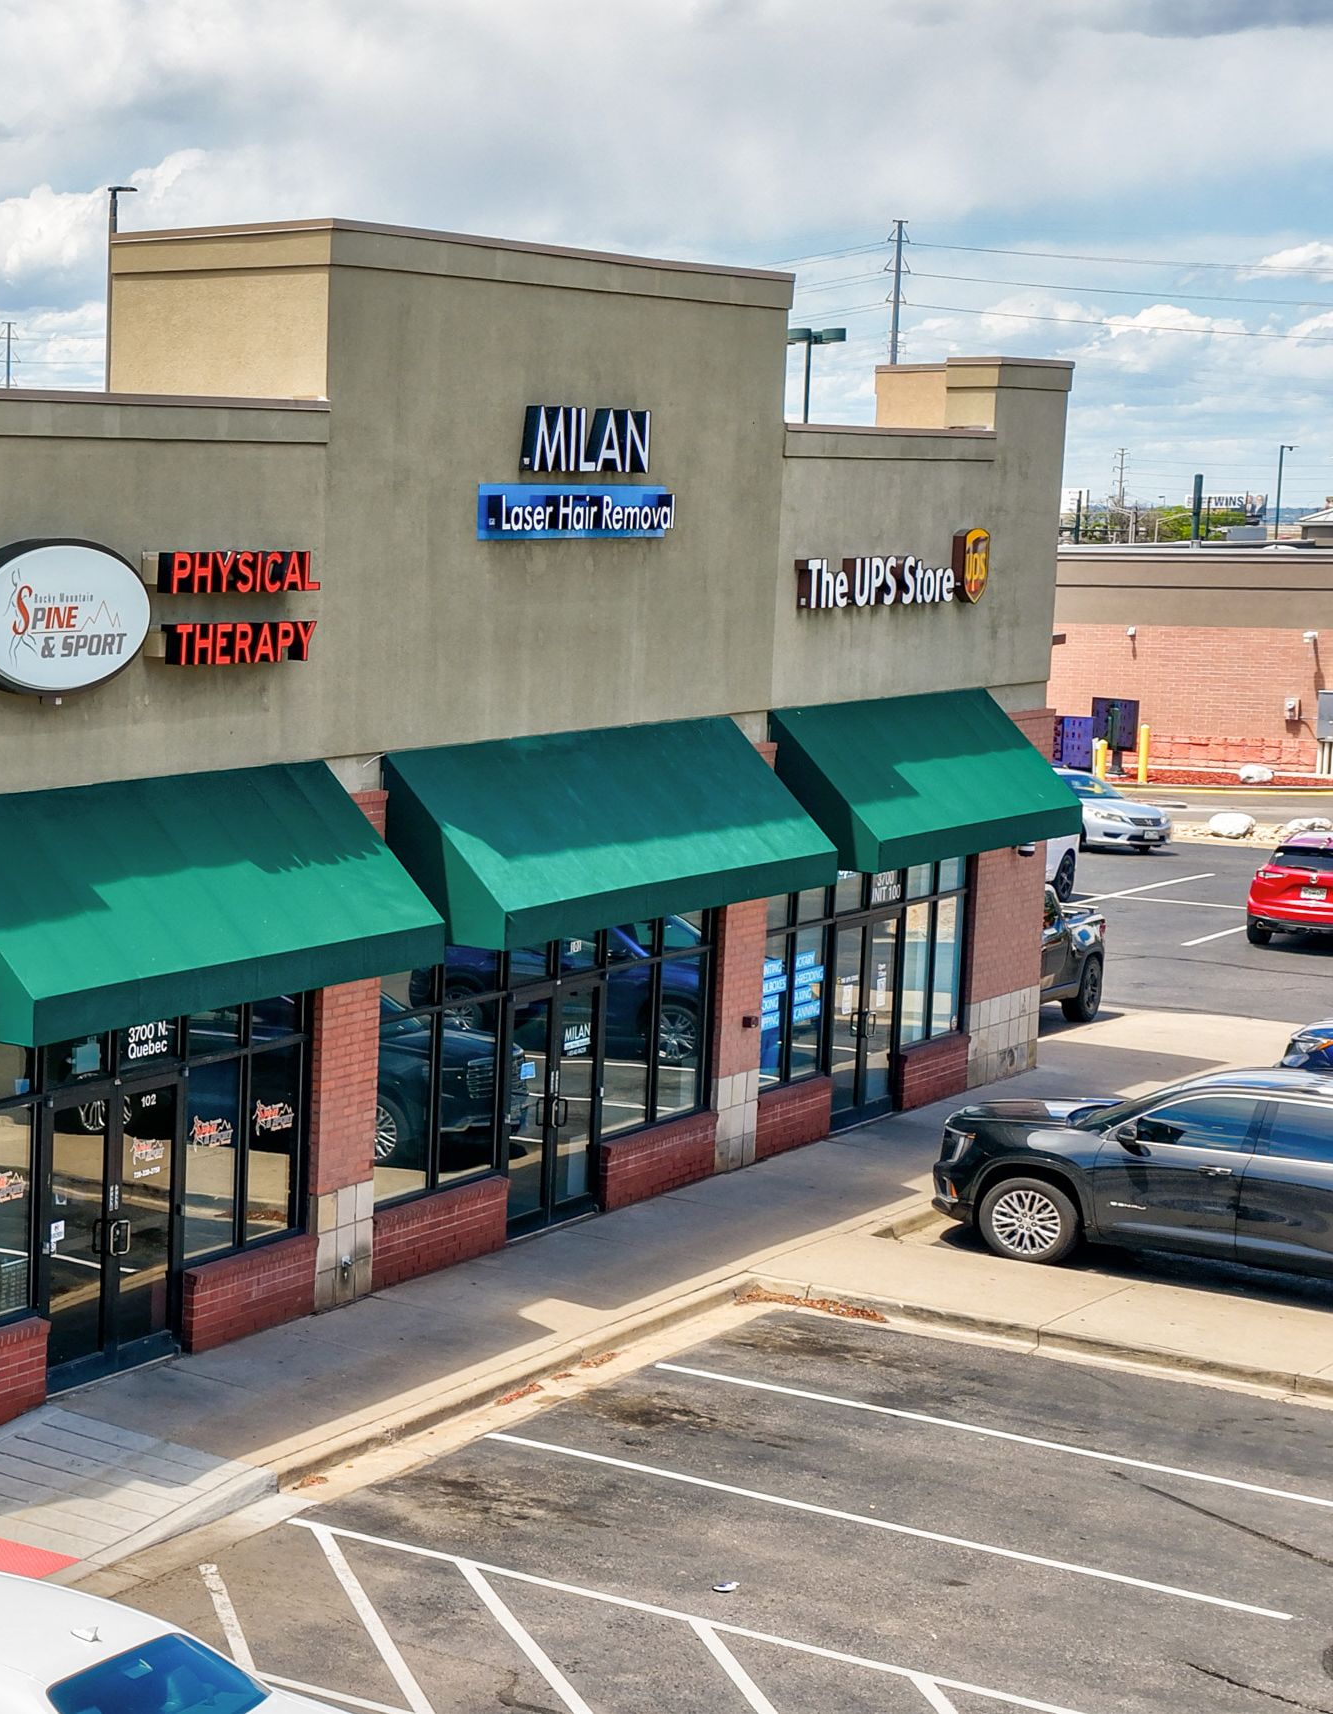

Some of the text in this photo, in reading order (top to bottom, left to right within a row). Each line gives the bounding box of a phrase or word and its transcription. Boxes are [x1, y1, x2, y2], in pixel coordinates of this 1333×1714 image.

[533, 405, 651, 473] MILAN
[501, 493, 676, 530] Laser Hair Removal
[1214, 495, 1244, 507] WINS
[172, 551, 321, 594] PHYSICAL
[807, 555, 955, 609] The UPS Store
[965, 552, 987, 593] ups
[12, 585, 79, 636] SPINE
[34, 592, 94, 606] Rocky Mountain
[41, 633, 128, 659] & SPORT
[176, 621, 318, 666] THERAPY
[889, 884, 901, 901] 100
[128, 1020, 169, 1043] 3700 N.
[564, 1022, 591, 1042] MILAN
[128, 1040, 168, 1059] Quebec
[141, 1093, 157, 1107] 102
